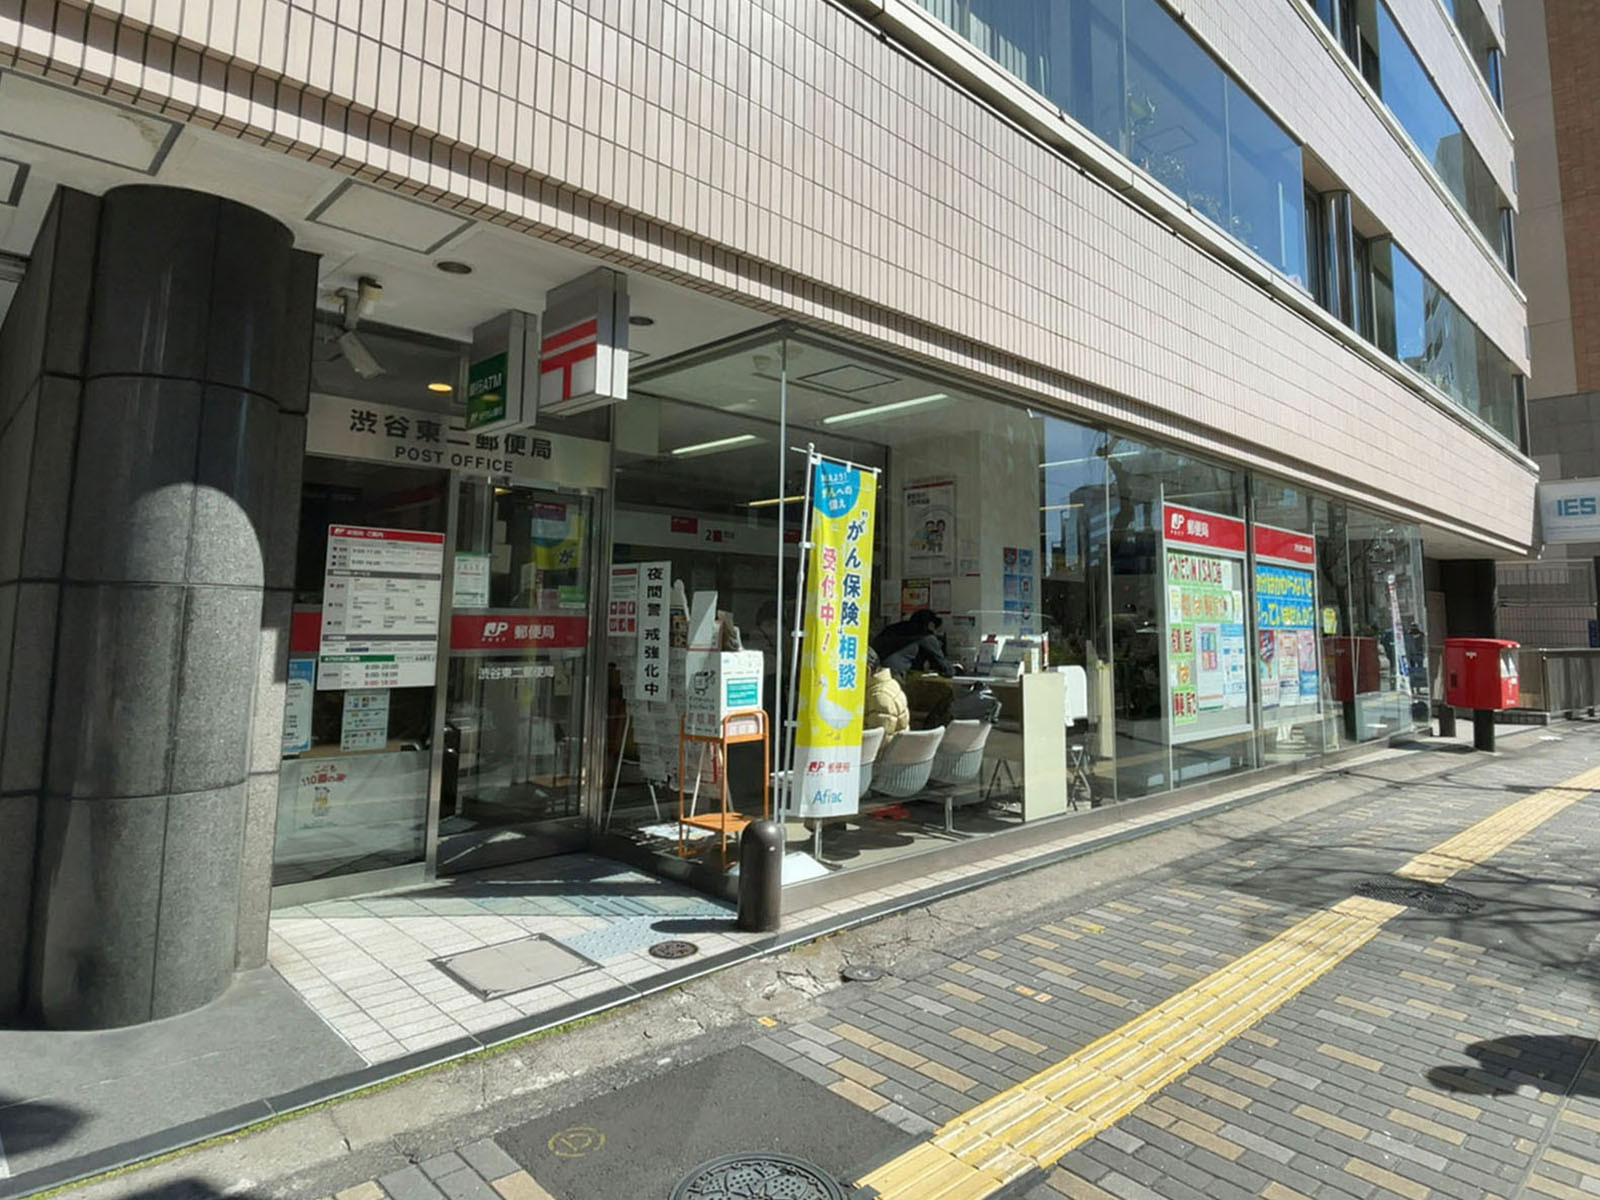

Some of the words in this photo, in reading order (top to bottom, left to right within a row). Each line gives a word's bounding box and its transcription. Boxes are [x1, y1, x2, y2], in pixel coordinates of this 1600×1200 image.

[349, 408, 553, 460] 渋谷東二郵便局
[395, 445, 445, 464] POST
[451, 453, 514, 473] OFFICE
[1557, 497, 1597, 516] IES
[514, 625, 555, 640] 郵便局
